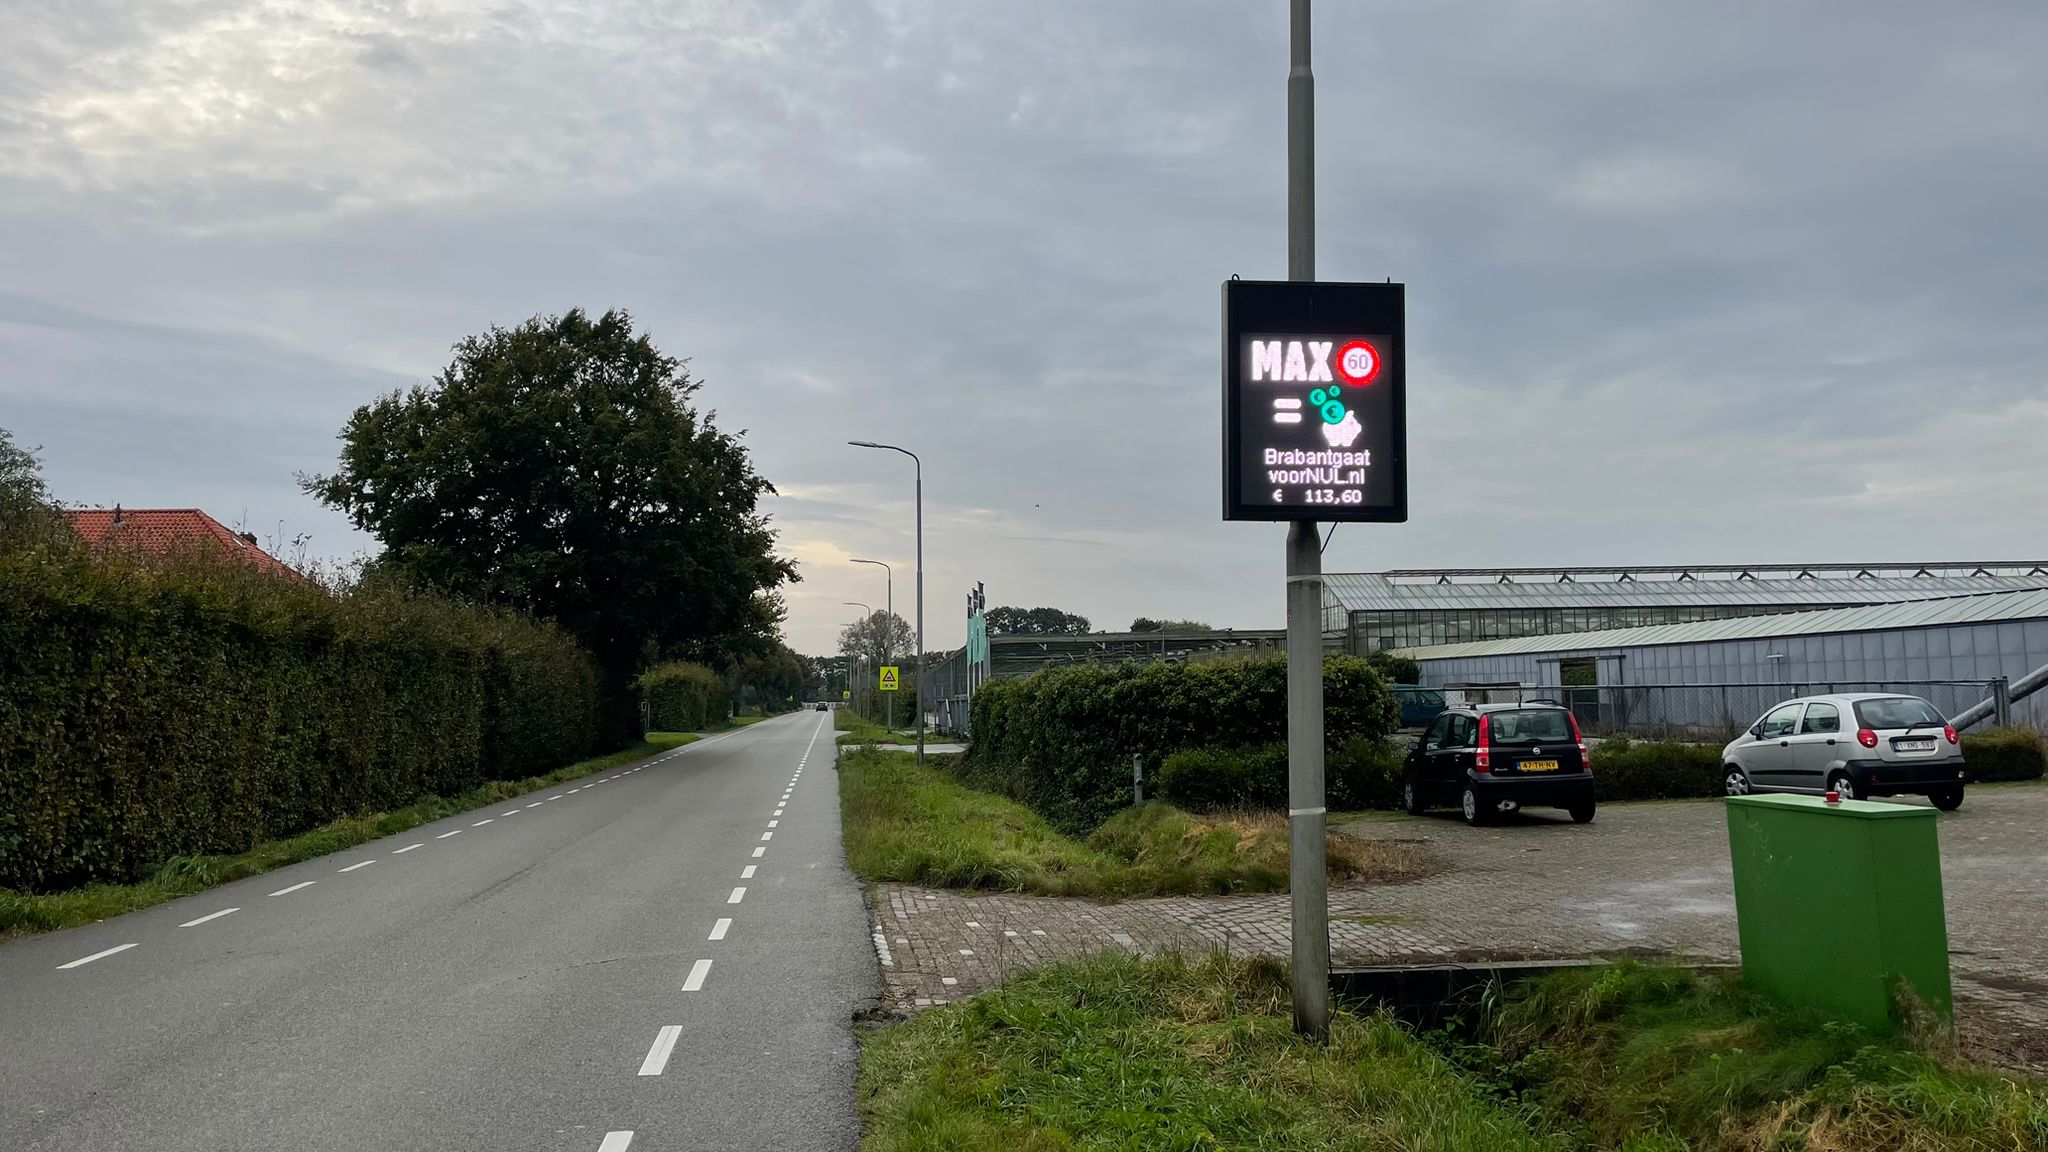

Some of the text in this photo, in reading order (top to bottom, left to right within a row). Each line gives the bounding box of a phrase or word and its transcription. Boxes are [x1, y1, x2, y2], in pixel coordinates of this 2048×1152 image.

[1252, 341, 1369, 381] MAX 60
[1264, 448, 1371, 468] Brabantgaat
[1268, 468, 1365, 484] voorNUL.nl
[1272, 489, 1362, 504] € 113,60
